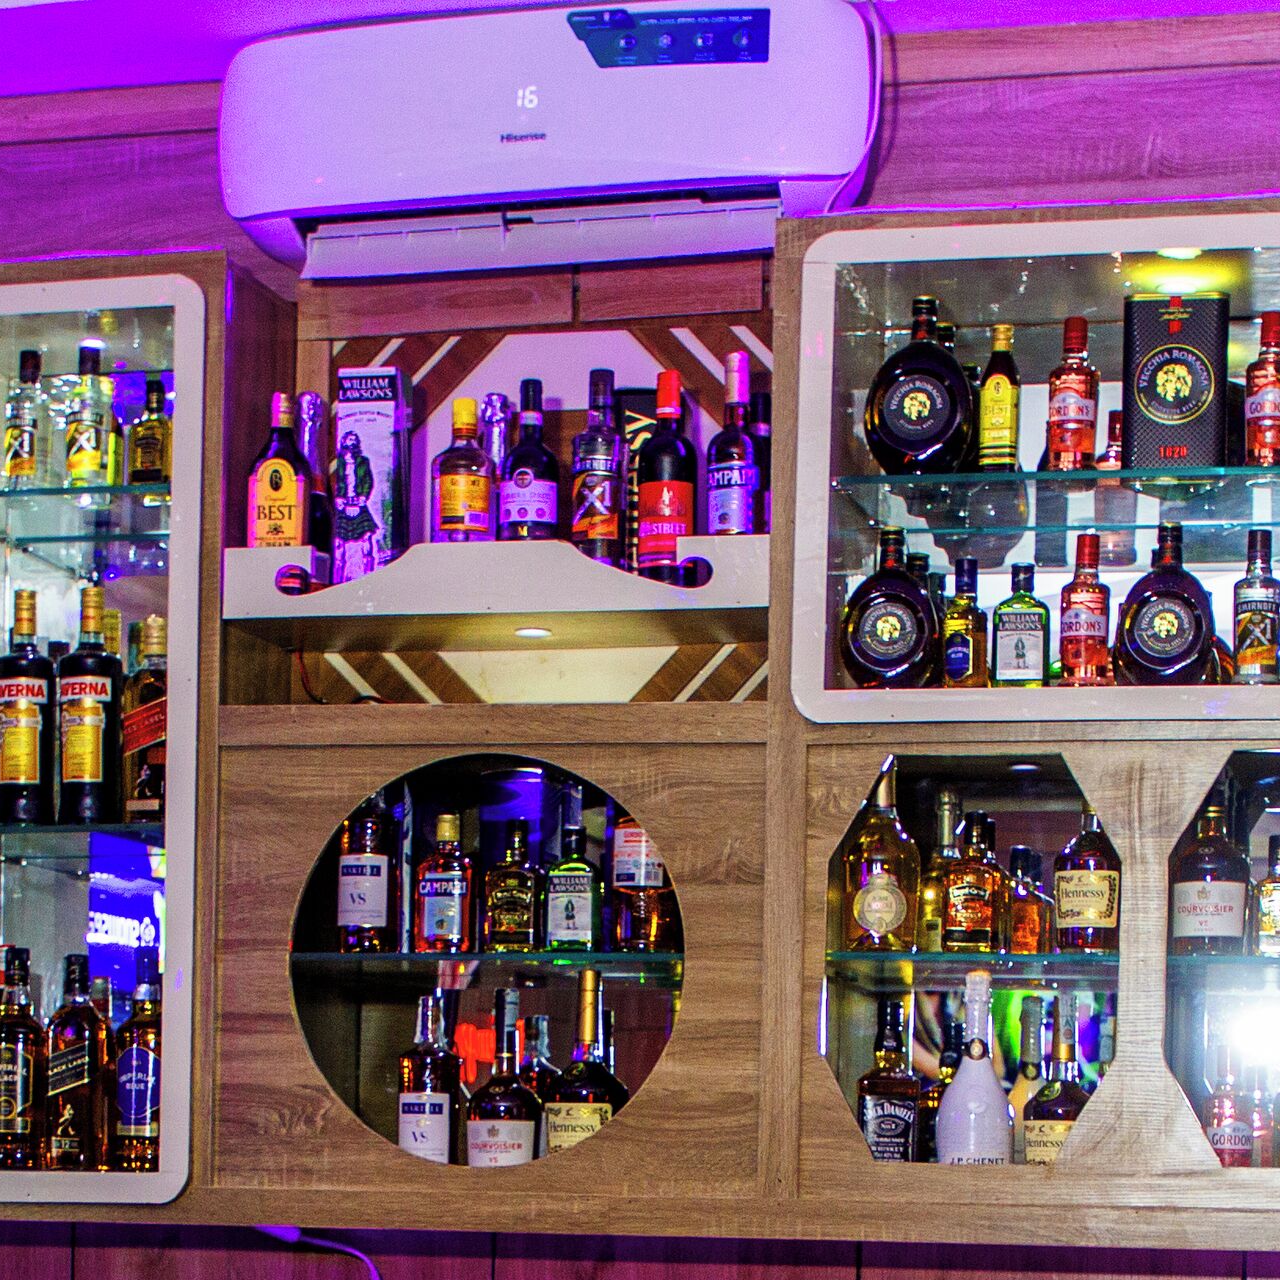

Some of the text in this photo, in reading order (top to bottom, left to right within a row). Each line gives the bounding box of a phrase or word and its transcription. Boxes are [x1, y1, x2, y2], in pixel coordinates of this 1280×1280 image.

[517, 86, 539, 109] 16
[500, 132, 546, 143] Hisense
[1139, 352, 1170, 388] VECCHIA
[342, 378, 389, 389] WILLIAM
[339, 388, 393, 400] LAWSON'S
[257, 504, 296, 521] BEST
[1001, 613, 1040, 622] WILLIAM
[999, 621, 1041, 631] LAWSON'S
[552, 877, 589, 886] WILLIAM
[419, 881, 467, 894] CAMPARI
[549, 885, 591, 894] LAWSON'S
[349, 892, 367, 905] VS
[1061, 888, 1105, 900] Hennessy
[1177, 904, 1234, 914] COURVOISIER
